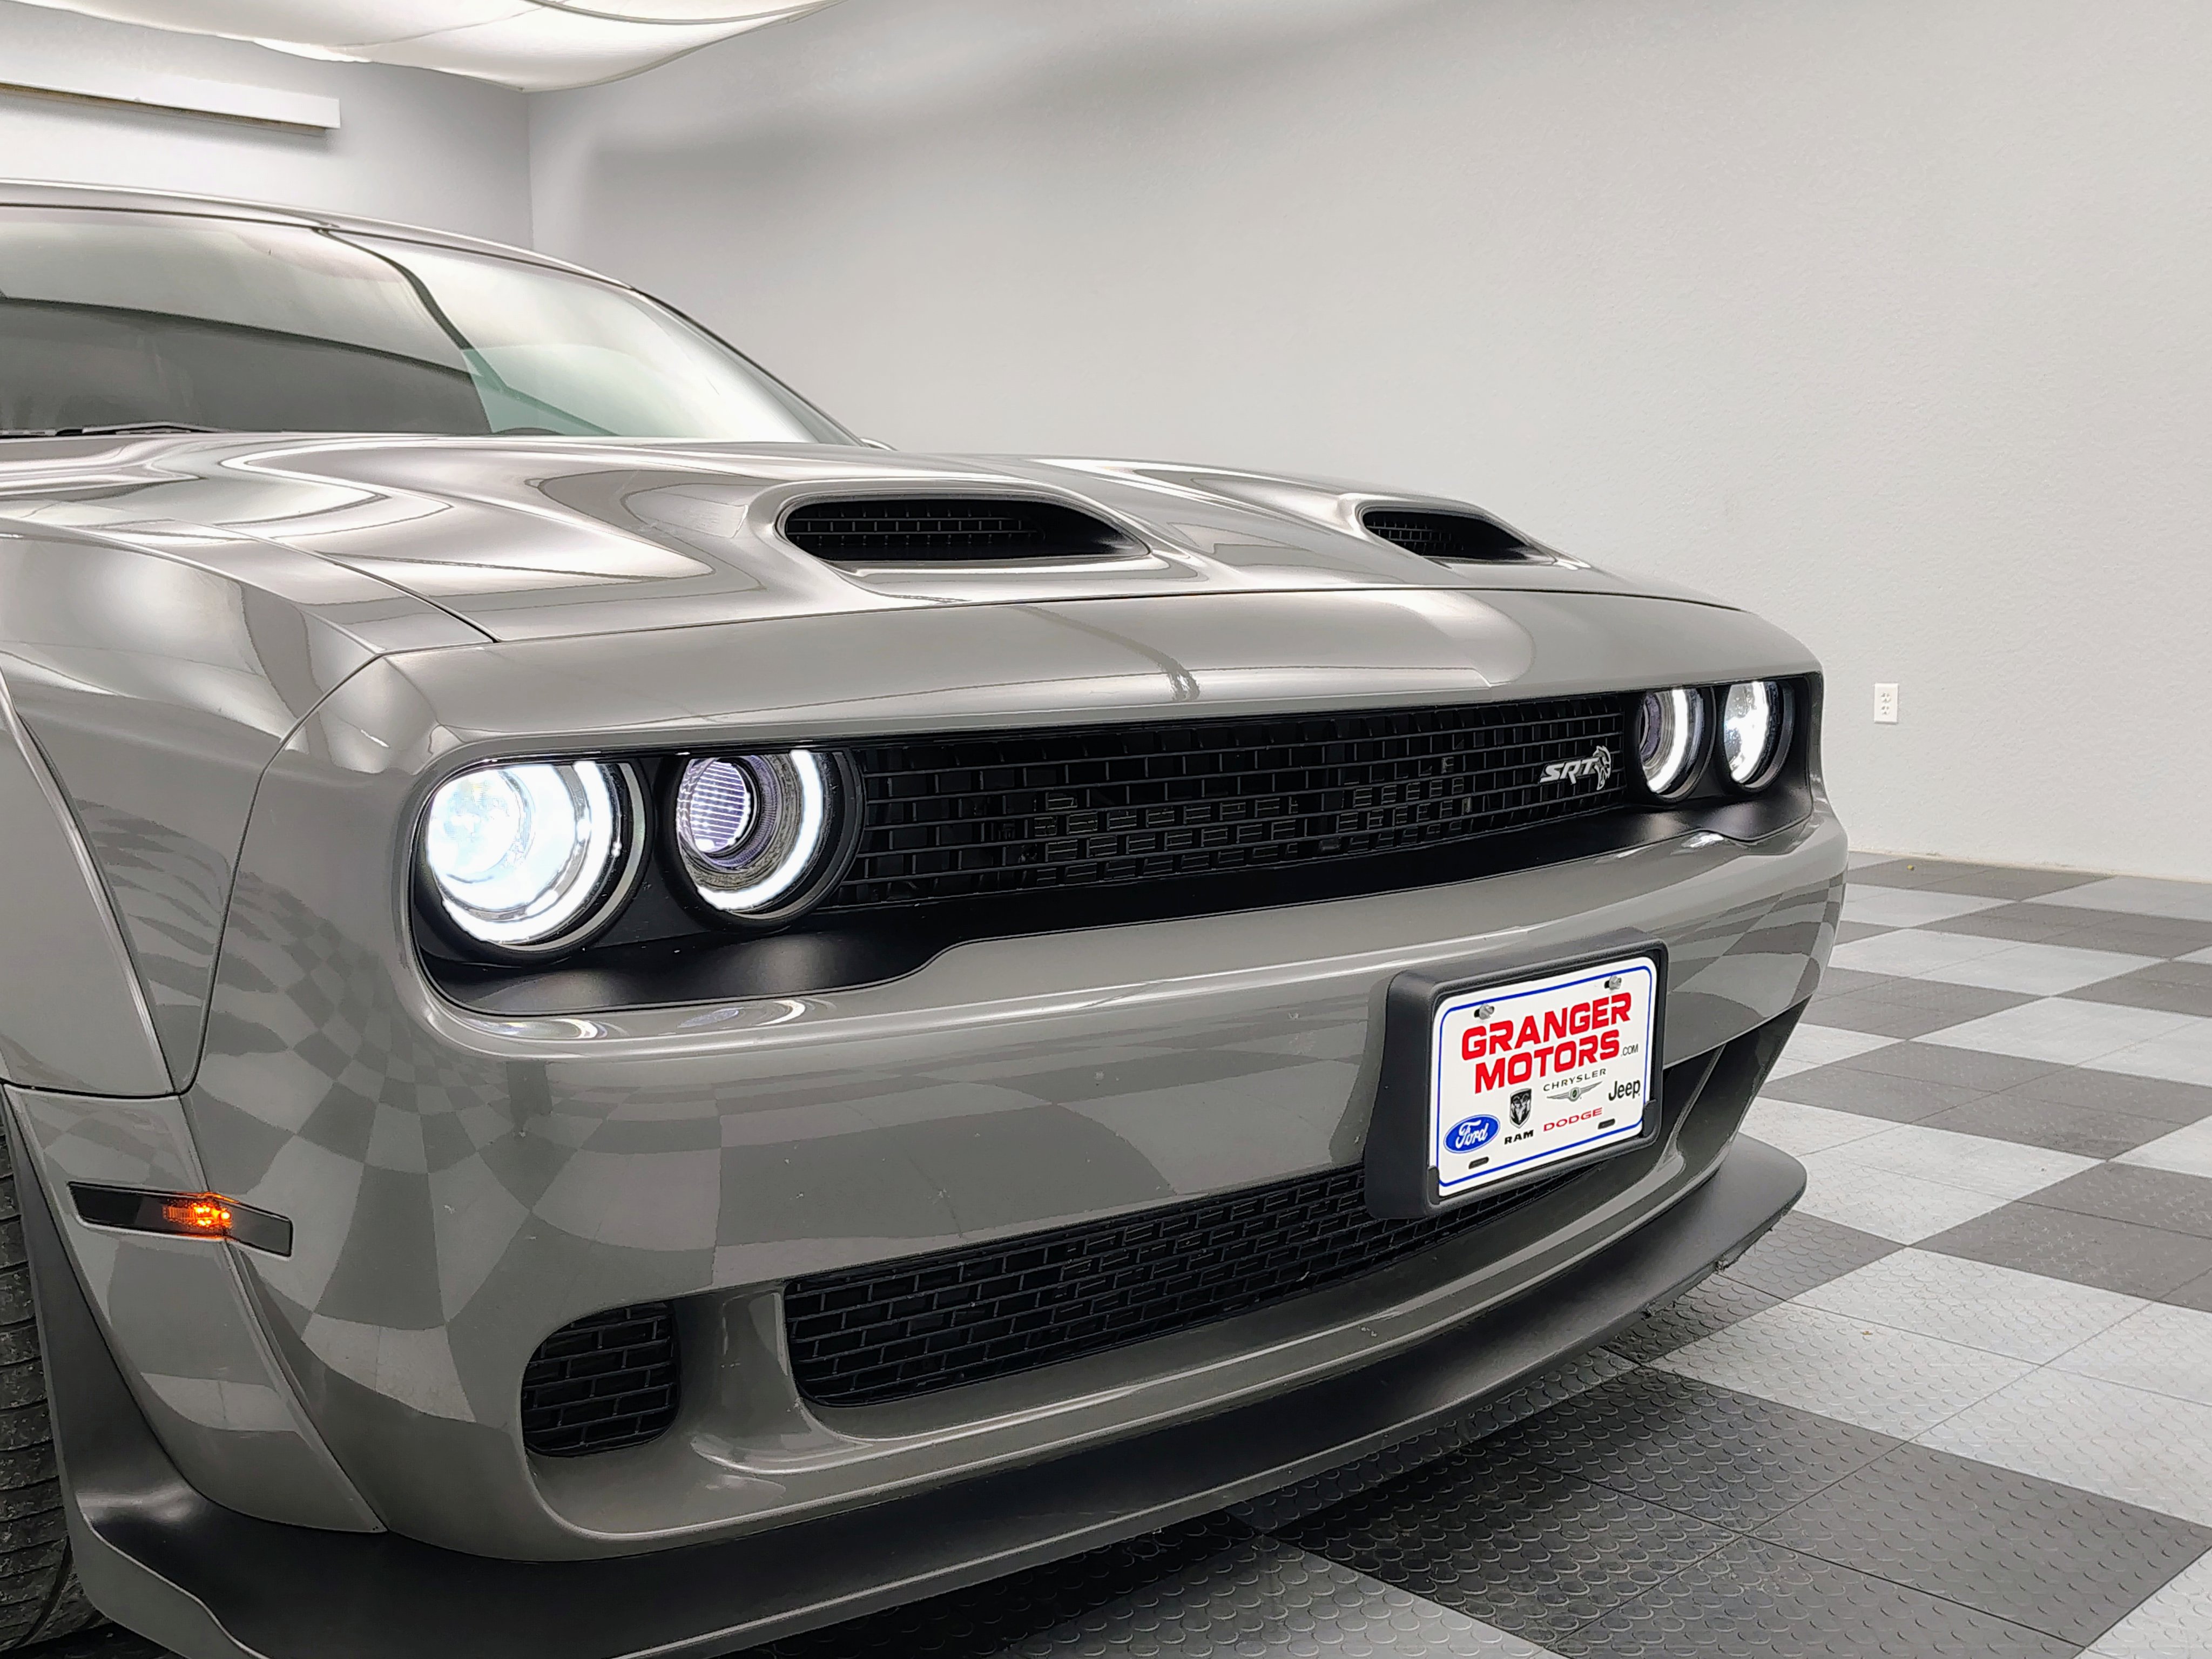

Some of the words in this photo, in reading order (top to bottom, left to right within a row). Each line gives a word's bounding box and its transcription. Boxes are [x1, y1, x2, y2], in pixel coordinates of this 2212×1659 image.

[1540, 757, 1599, 785] SRT
[1461, 992, 1631, 1061] GRANGER
[1475, 1029, 1620, 1094] MOTORS
[1543, 1068, 1606, 1091] CHRYSLER
[1608, 1080, 1641, 1101] Jeep
[1543, 1107, 1602, 1131] DODGE
[1455, 1120, 1489, 1149] Ford
[1504, 1130, 1534, 1144] RAM
